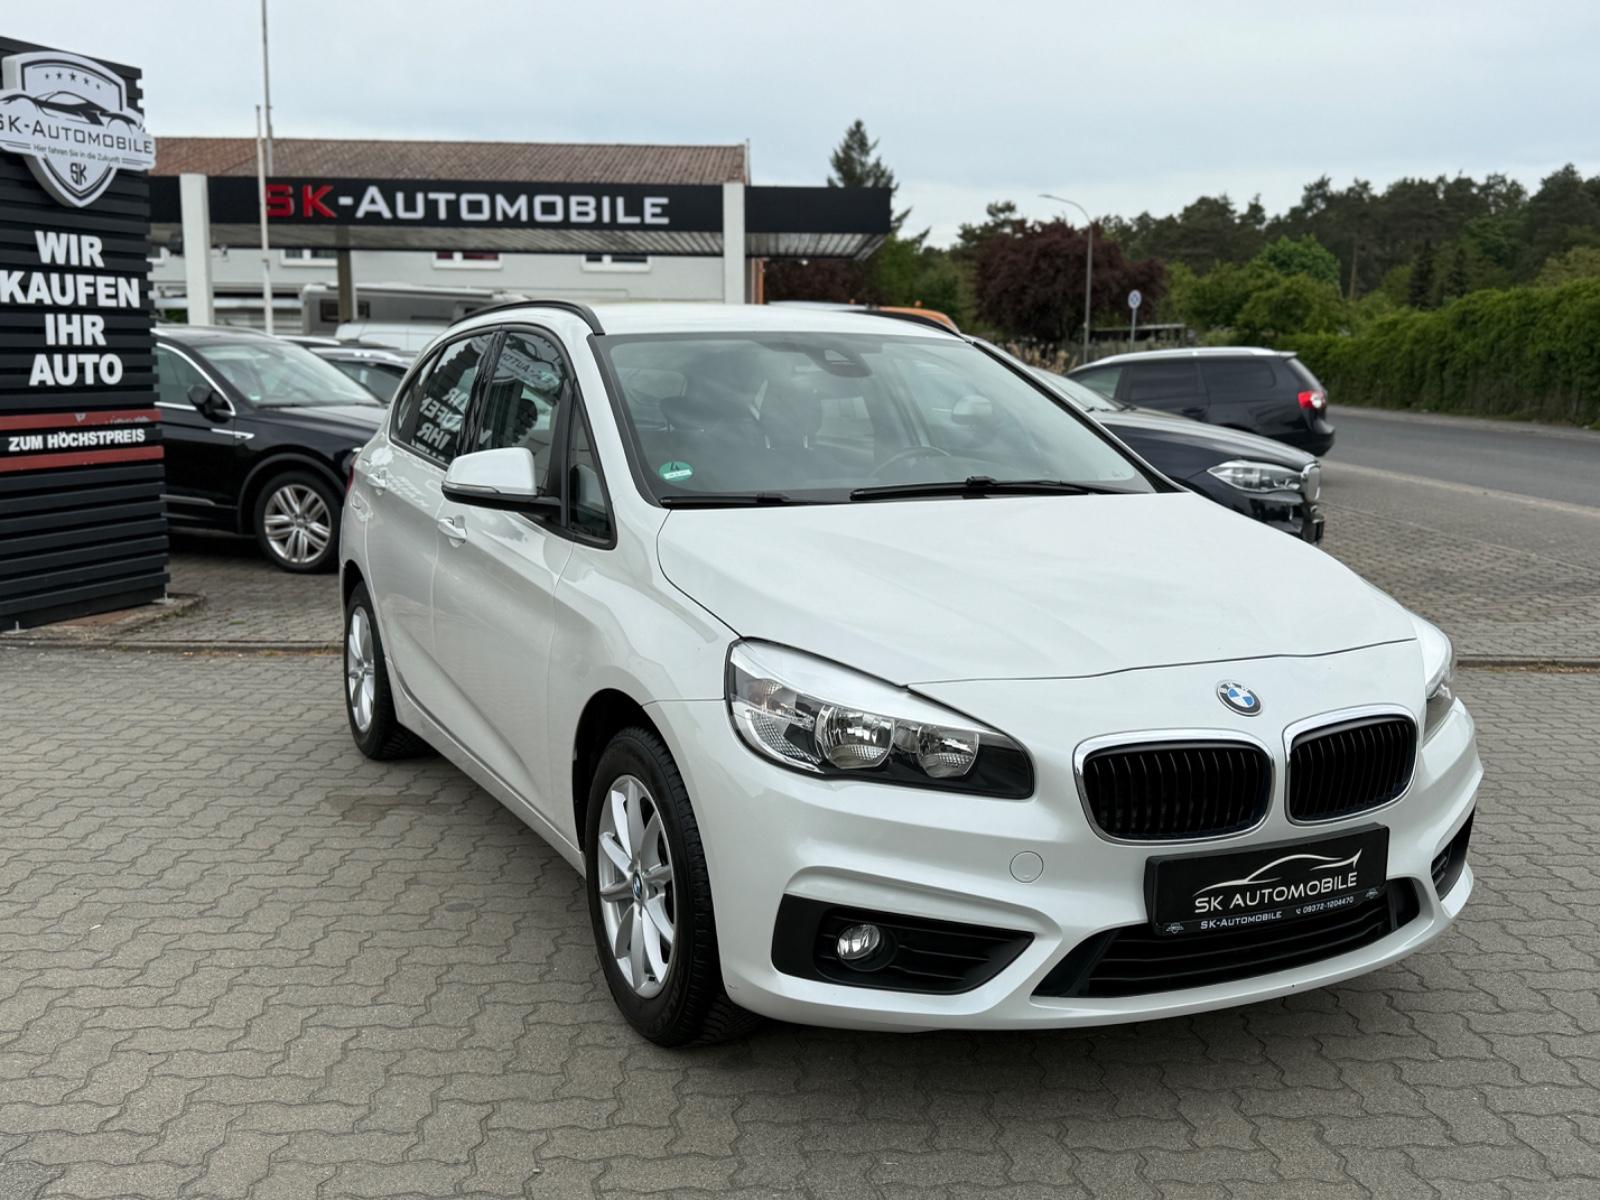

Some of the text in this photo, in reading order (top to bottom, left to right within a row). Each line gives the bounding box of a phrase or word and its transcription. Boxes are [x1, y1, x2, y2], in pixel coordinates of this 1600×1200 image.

[70, 162, 87, 186] SK
[266, 183, 670, 225] SK-AUTOMOBILE
[35, 230, 105, 267] WIR
[0, 269, 140, 308] KAUFEN
[45, 313, 107, 346] IHR
[29, 353, 123, 386] AUTO
[8, 428, 146, 452] ZUM HÖCHSTPREIS
[1194, 871, 1358, 913] SK AUTOMOBILE
[1200, 911, 1282, 930] SK-AUTOMOBILE
